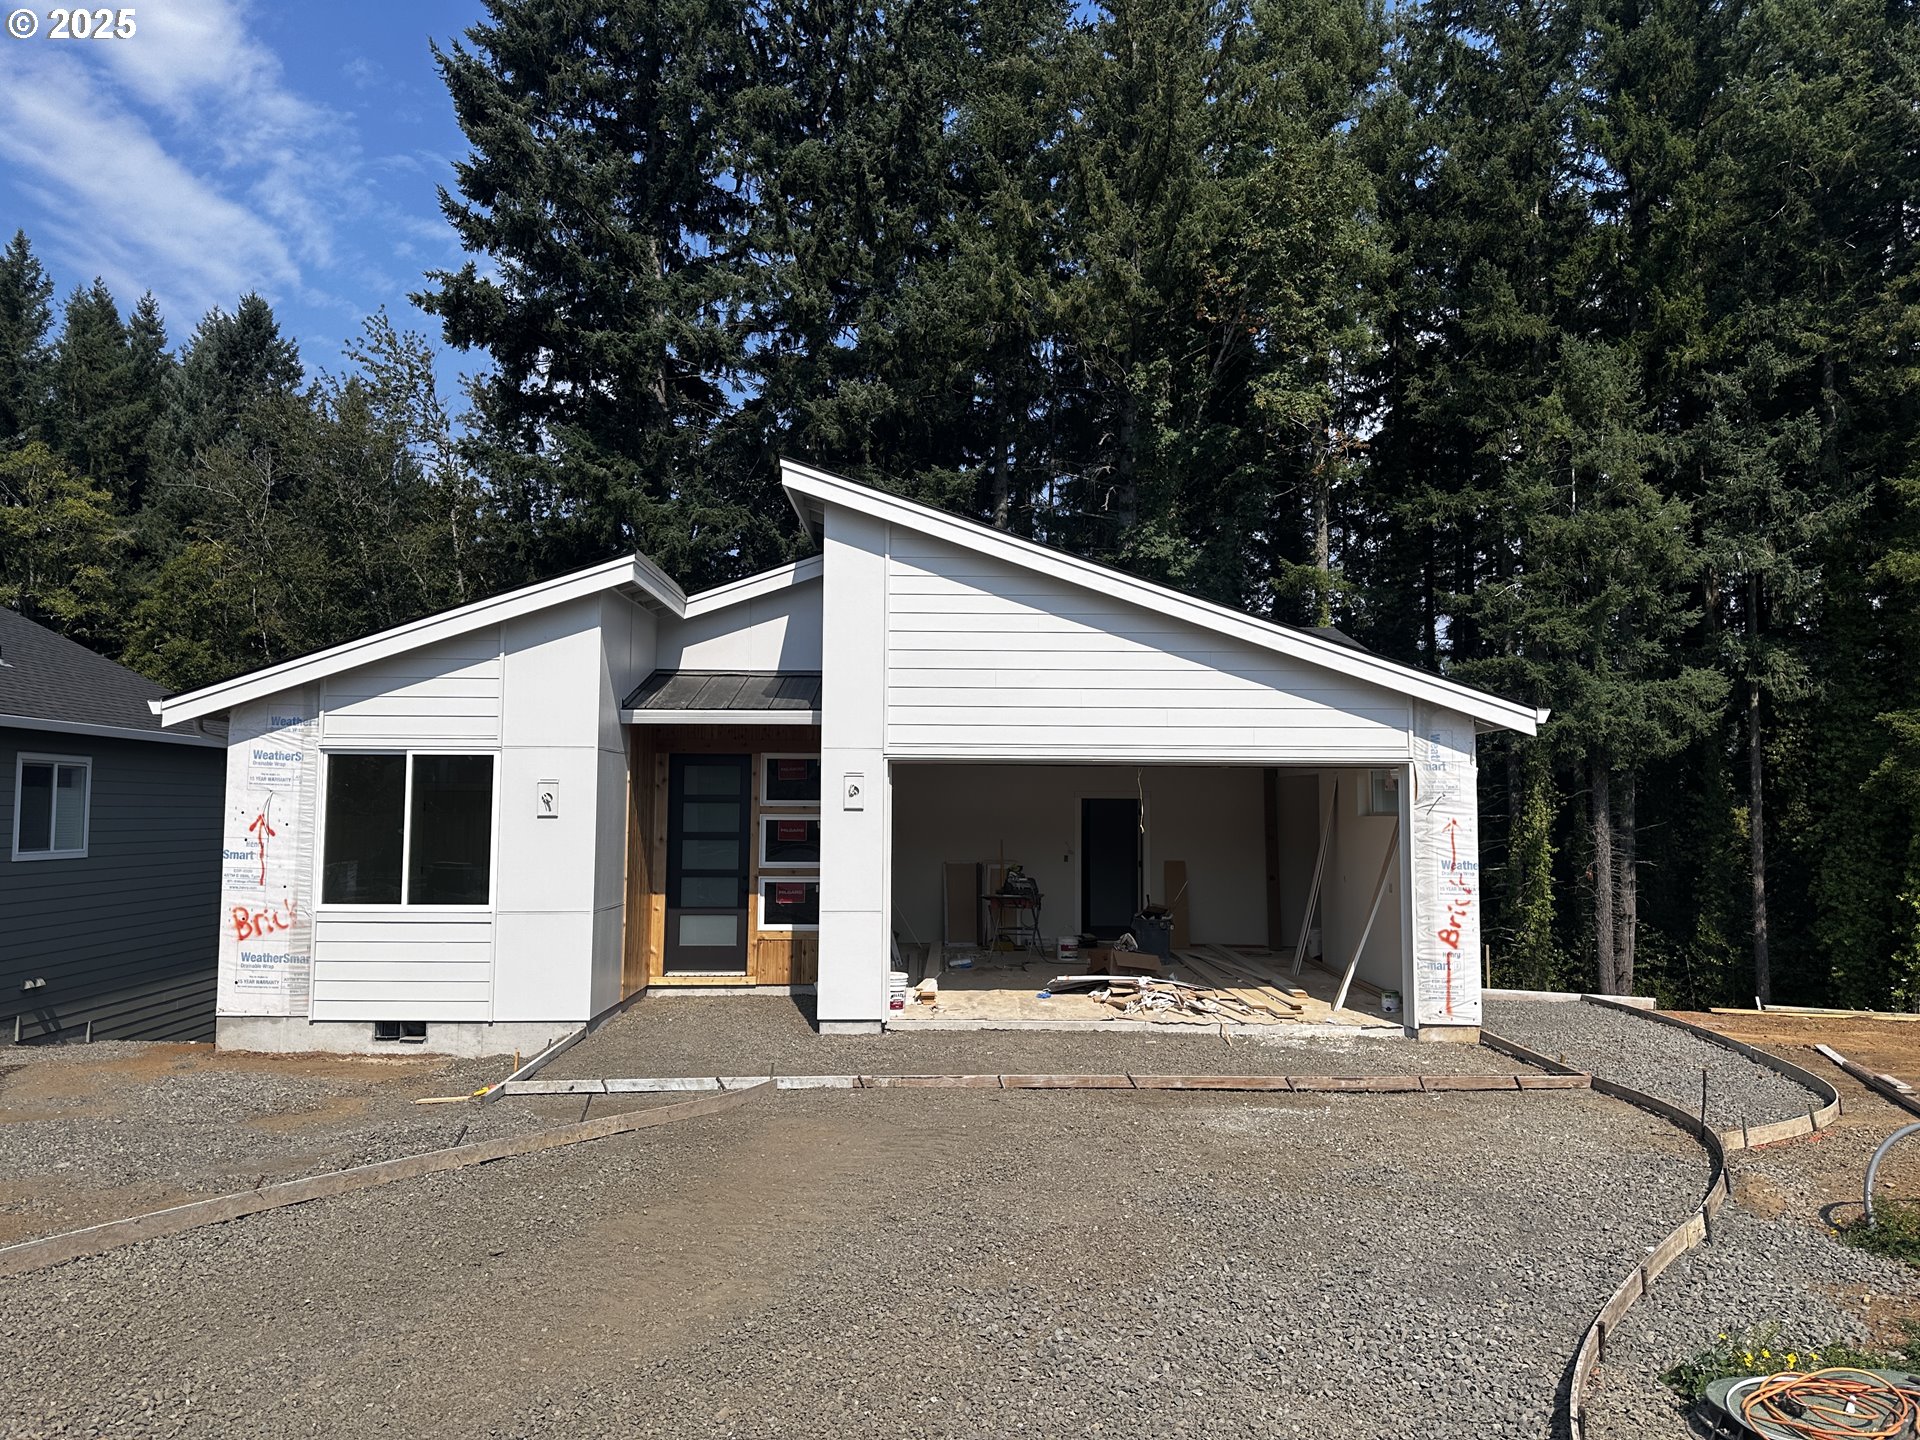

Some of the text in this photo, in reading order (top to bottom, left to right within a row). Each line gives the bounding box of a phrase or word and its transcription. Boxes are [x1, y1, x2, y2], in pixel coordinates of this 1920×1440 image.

[271, 716, 319, 727] Weather
[223, 849, 255, 860] Smart
[1442, 952, 1462, 960] Hnry
